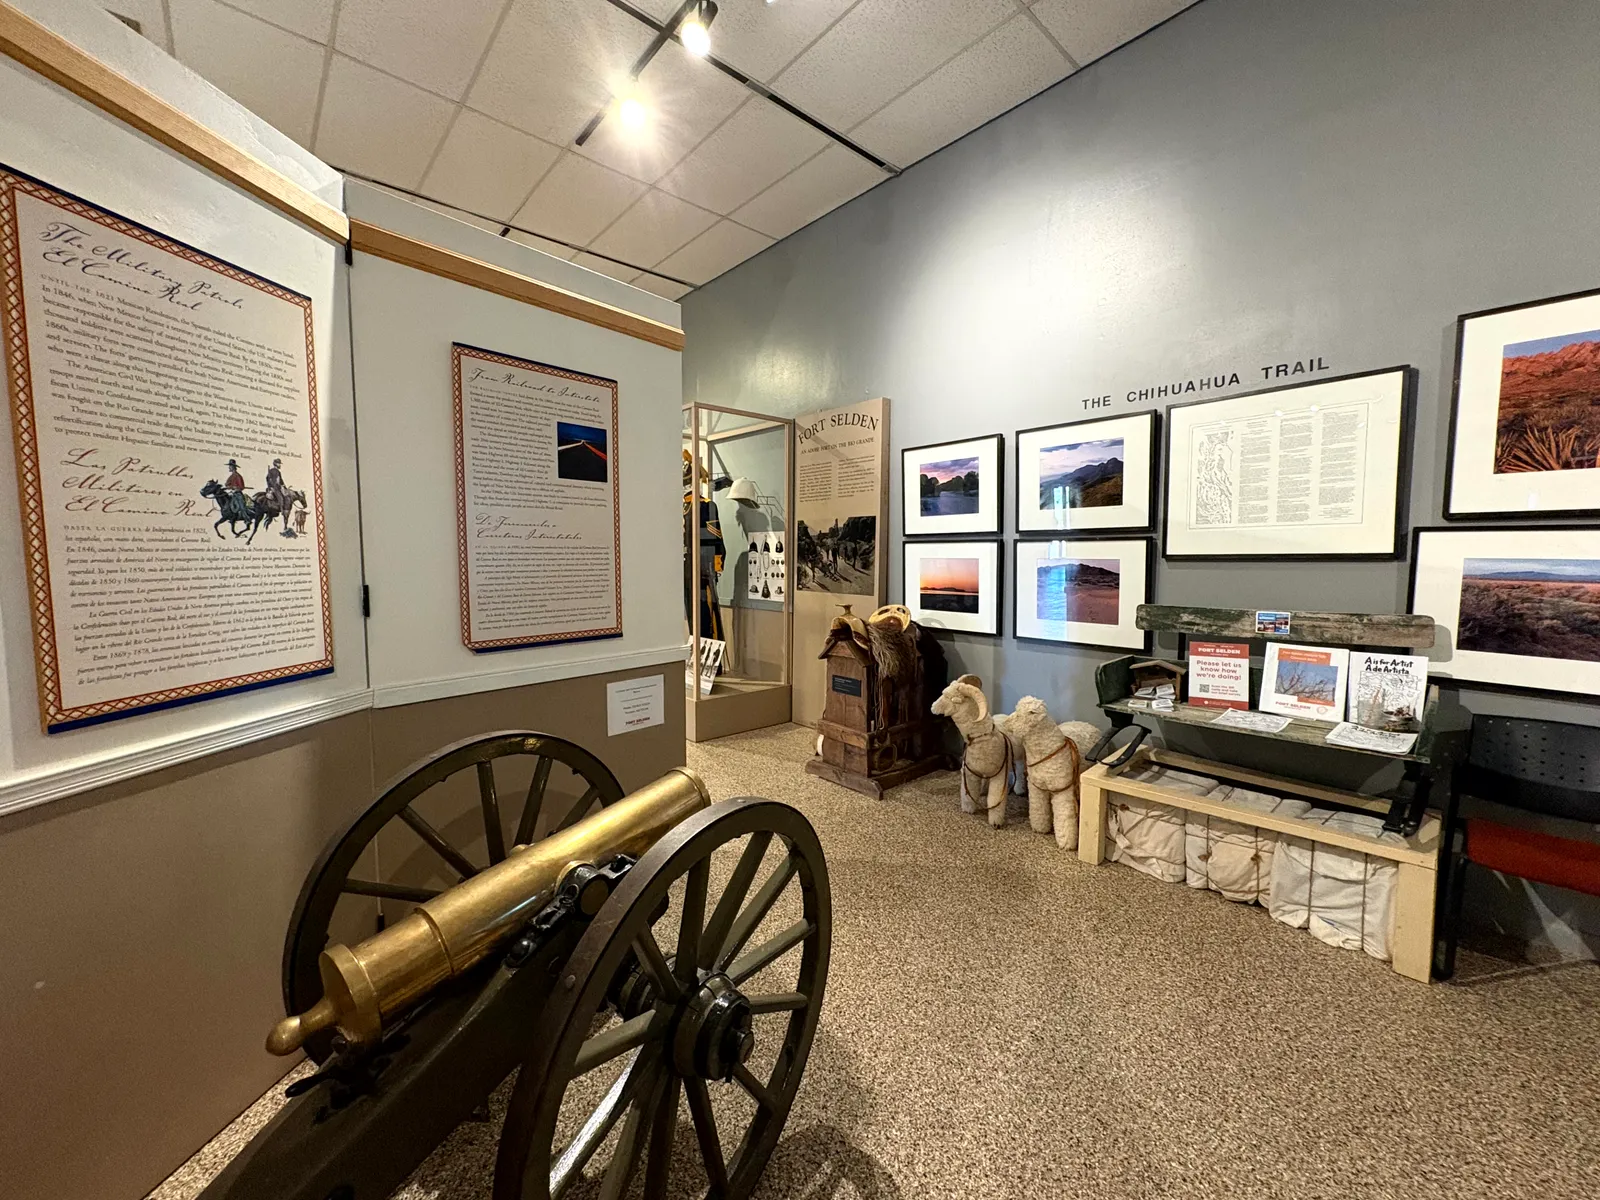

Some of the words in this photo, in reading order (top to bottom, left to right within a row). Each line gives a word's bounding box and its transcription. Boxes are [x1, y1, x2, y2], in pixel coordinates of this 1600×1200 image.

[39, 222, 91, 249] The
[92, 246, 182, 288] Military
[43, 247, 78, 266] El
[81, 258, 152, 294] Camino
[157, 285, 202, 310] Real
[84, 365, 116, 376] American
[467, 367, 499, 383] From
[546, 386, 556, 394] to
[1082, 395, 1112, 410] THE
[1126, 373, 1240, 403] CHIHUAHUA
[1261, 357, 1330, 380] TRAIL
[798, 418, 826, 444] FORT
[830, 413, 879, 431] SELDEN
[60, 448, 106, 469] Las
[111, 458, 193, 478] Patrullas
[65, 495, 99, 511] El
[102, 497, 169, 515] Camino
[174, 500, 215, 517] Real
[475, 513, 492, 526] De
[1364, 656, 1372, 664] A
[1390, 659, 1414, 668] Artist
[1383, 666, 1410, 674] Artista
